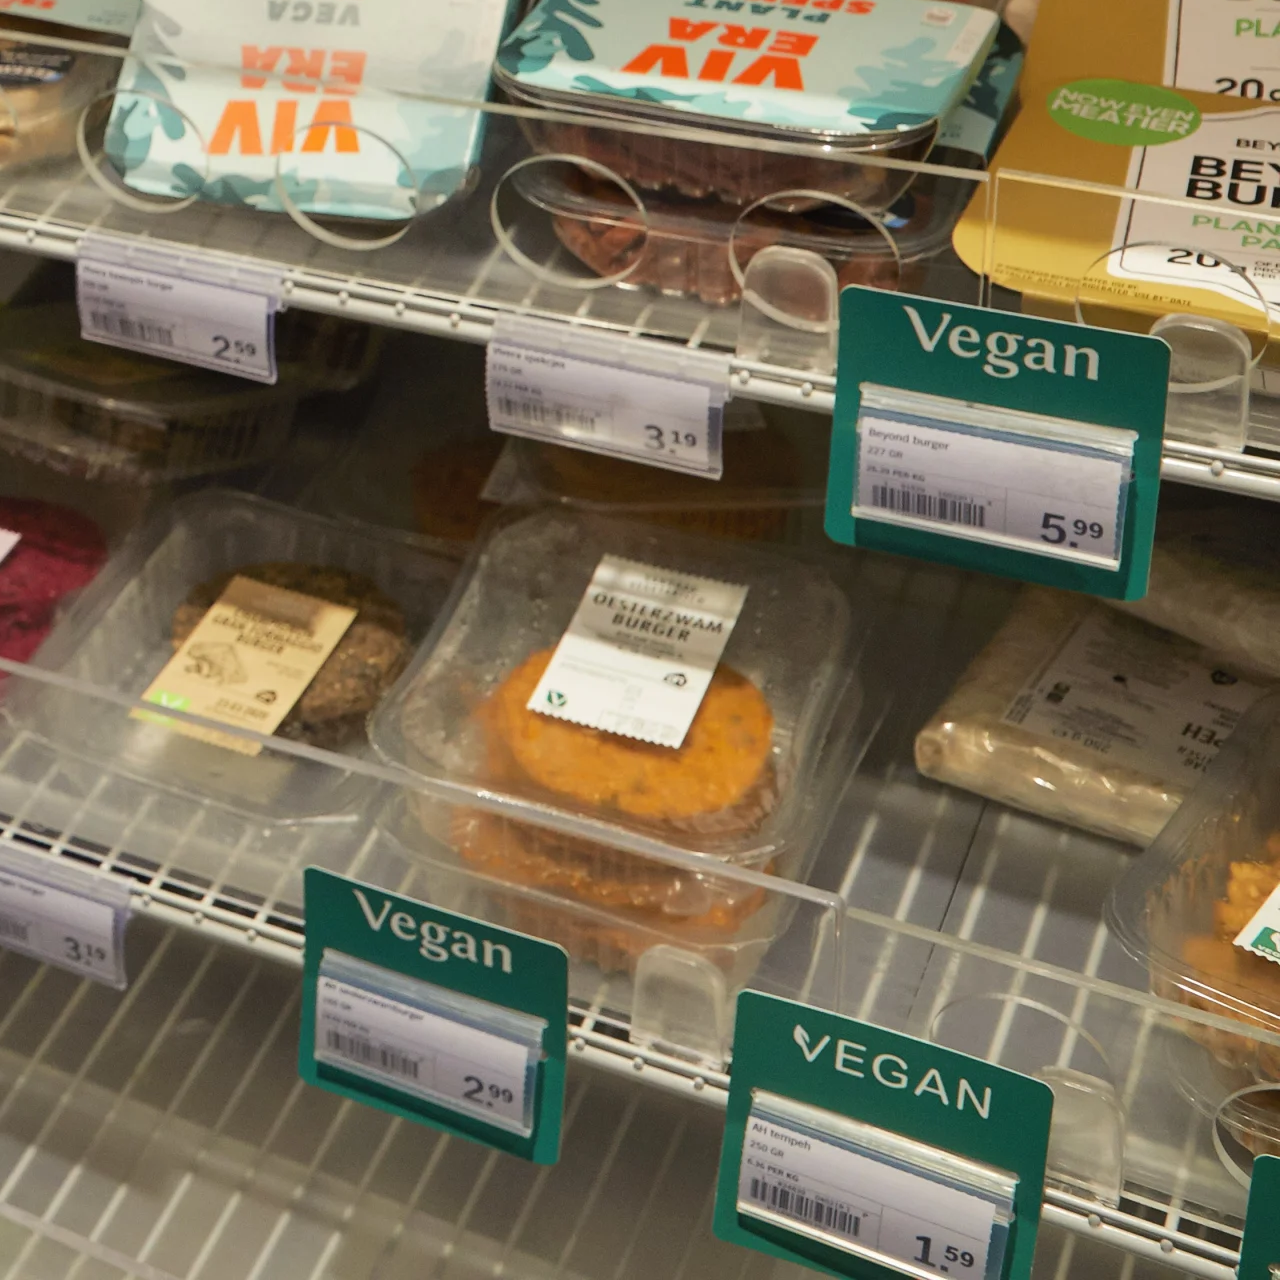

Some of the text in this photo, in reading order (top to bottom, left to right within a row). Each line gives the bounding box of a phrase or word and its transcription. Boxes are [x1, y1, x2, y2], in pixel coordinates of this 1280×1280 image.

[267, 0, 361, 27] VEGA
[666, 17, 820, 58] ERA
[241, 44, 368, 96] ERA
[619, 44, 806, 91] VIV
[1051, 99, 1191, 135] MEATIER
[1057, 88, 1195, 122] NOW EVEN
[206, 99, 361, 157] VIV
[902, 305, 1101, 381] Vegan
[643, 424, 697, 455] 3.19
[868, 427, 950, 451] Beyond burger
[1040, 511, 1104, 549] 5.99
[593, 592, 725, 635] OESTERZWAM
[611, 613, 691, 643] BURGER
[352, 888, 513, 974] Vegan
[792, 1023, 993, 1121] VEGAN
[462, 1074, 515, 1109] 2.99
[749, 1139, 769, 1153] 250
[752, 1122, 812, 1152] AH tempeh
[785, 1171, 799, 1183] KG
[913, 1234, 976, 1273] 1.59
